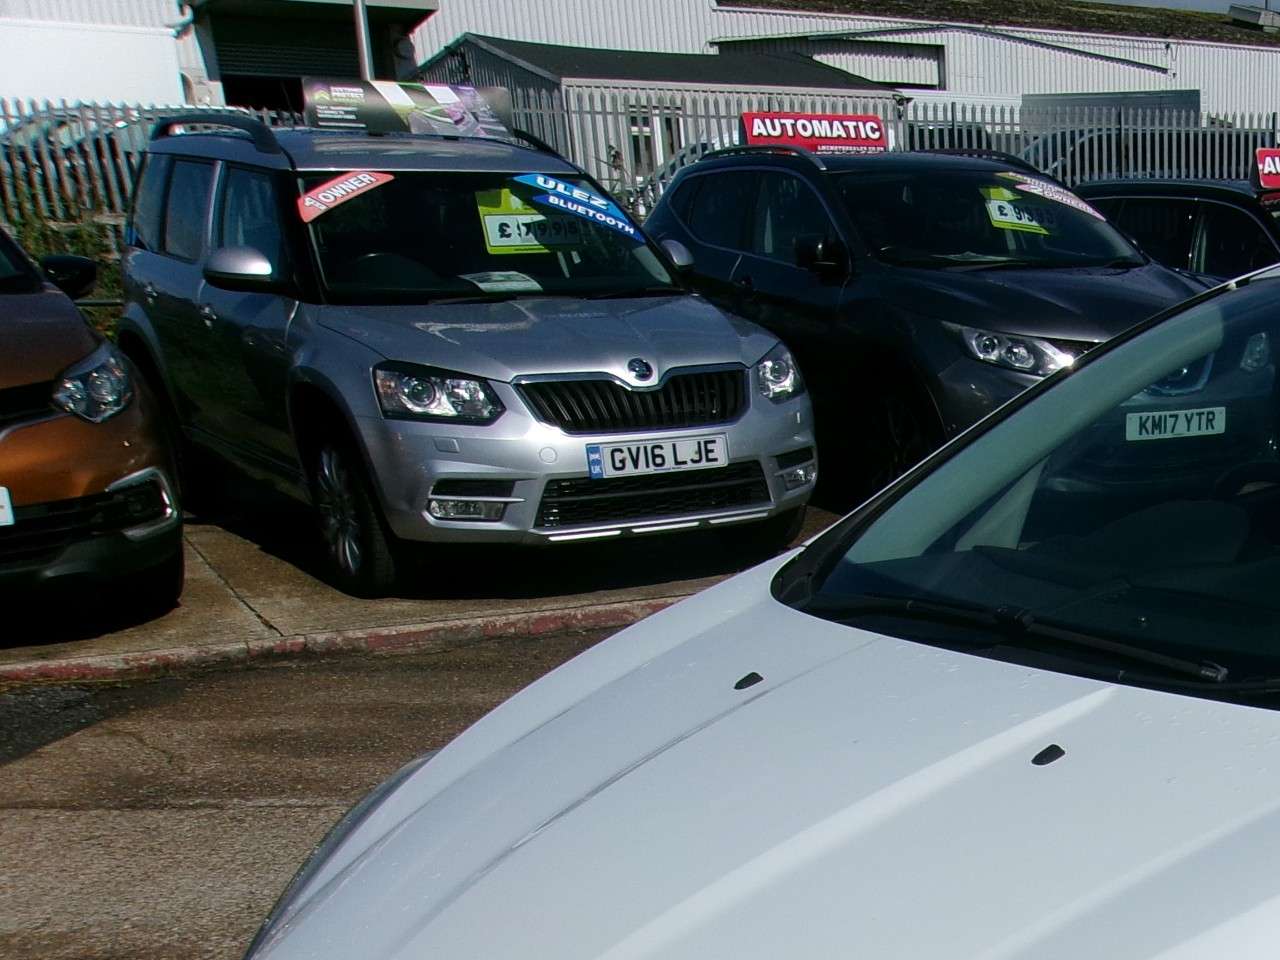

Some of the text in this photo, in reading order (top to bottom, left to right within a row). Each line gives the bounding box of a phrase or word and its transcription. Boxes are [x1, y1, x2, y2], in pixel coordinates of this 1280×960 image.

[751, 117, 882, 140] AUTOMATIC
[318, 172, 377, 204] OWNER
[535, 174, 609, 211] ULEZ
[548, 194, 635, 235] BLUETOOTH
[1138, 410, 1216, 436] KM17 YTR
[610, 439, 719, 472] GV16 LJE
